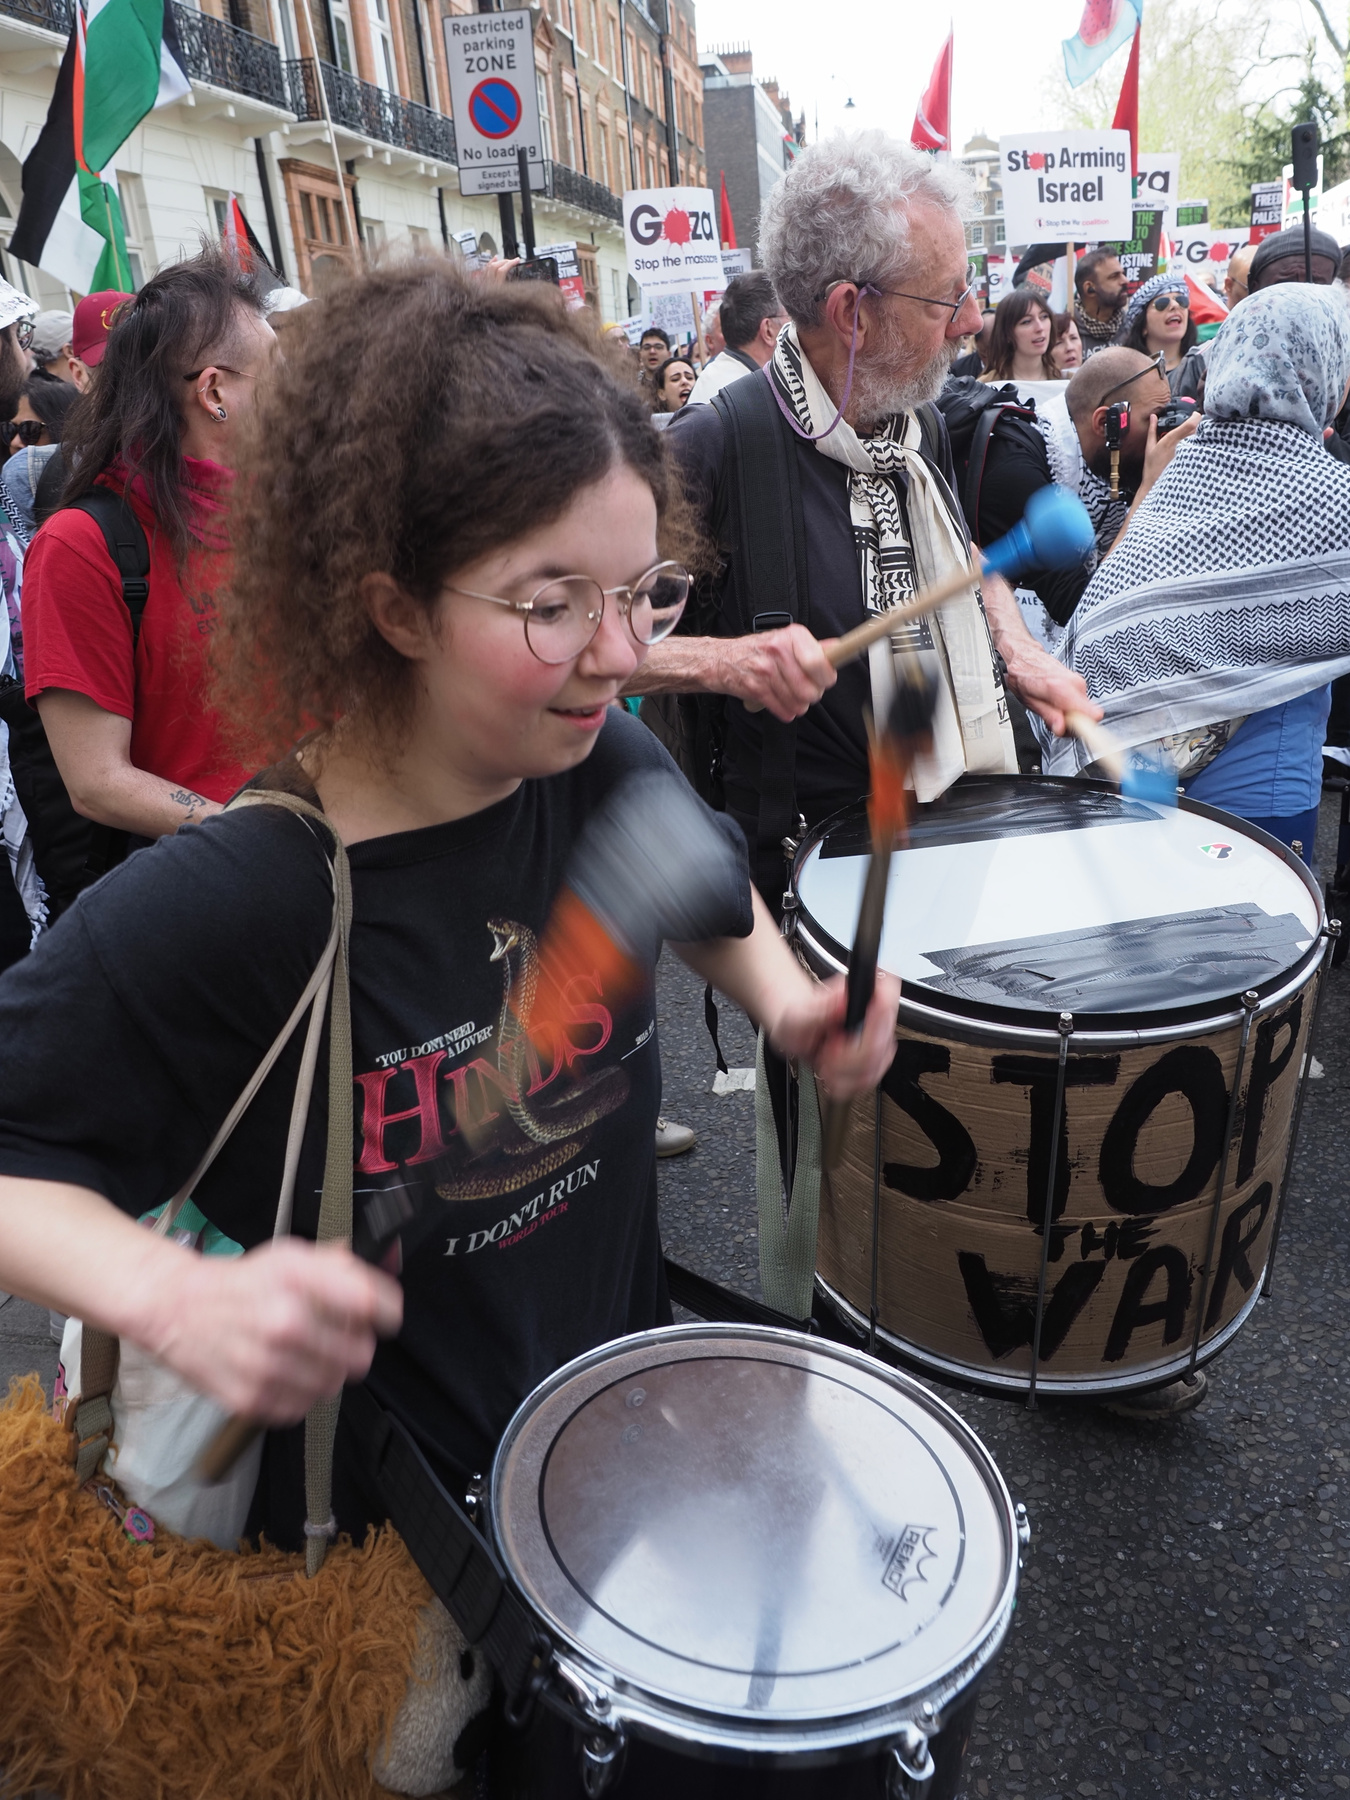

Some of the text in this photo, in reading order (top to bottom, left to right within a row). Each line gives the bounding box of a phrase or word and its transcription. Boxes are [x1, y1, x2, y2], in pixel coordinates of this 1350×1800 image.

[452, 17, 524, 36] Restricted
[463, 37, 515, 54] parking
[465, 54, 517, 73] ZONE
[463, 144, 536, 160] No loadg
[1059, 147, 1126, 173] Arming
[481, 170, 511, 179] Except
[478, 180, 505, 190] signed
[1037, 175, 1103, 203] Israel
[1135, 211, 1155, 225] THE
[1135, 225, 1149, 239] TO
[1124, 240, 1143, 254] SEA
[634, 259, 660, 271] Stop
[662, 256, 681, 268] the
[1126, 267, 1140, 281] BE
[444, 1021, 475, 1045] NEED
[447, 1046, 456, 1059] A
[880, 993, 1306, 1225] STOP
[443, 1159, 601, 1256] I DON'T RUN
[499, 1202, 569, 1249] WORLD TOUR
[1033, 1216, 1161, 1262] THE
[957, 1181, 1273, 1362] WAR
[888, 1530, 920, 1589] REMO
